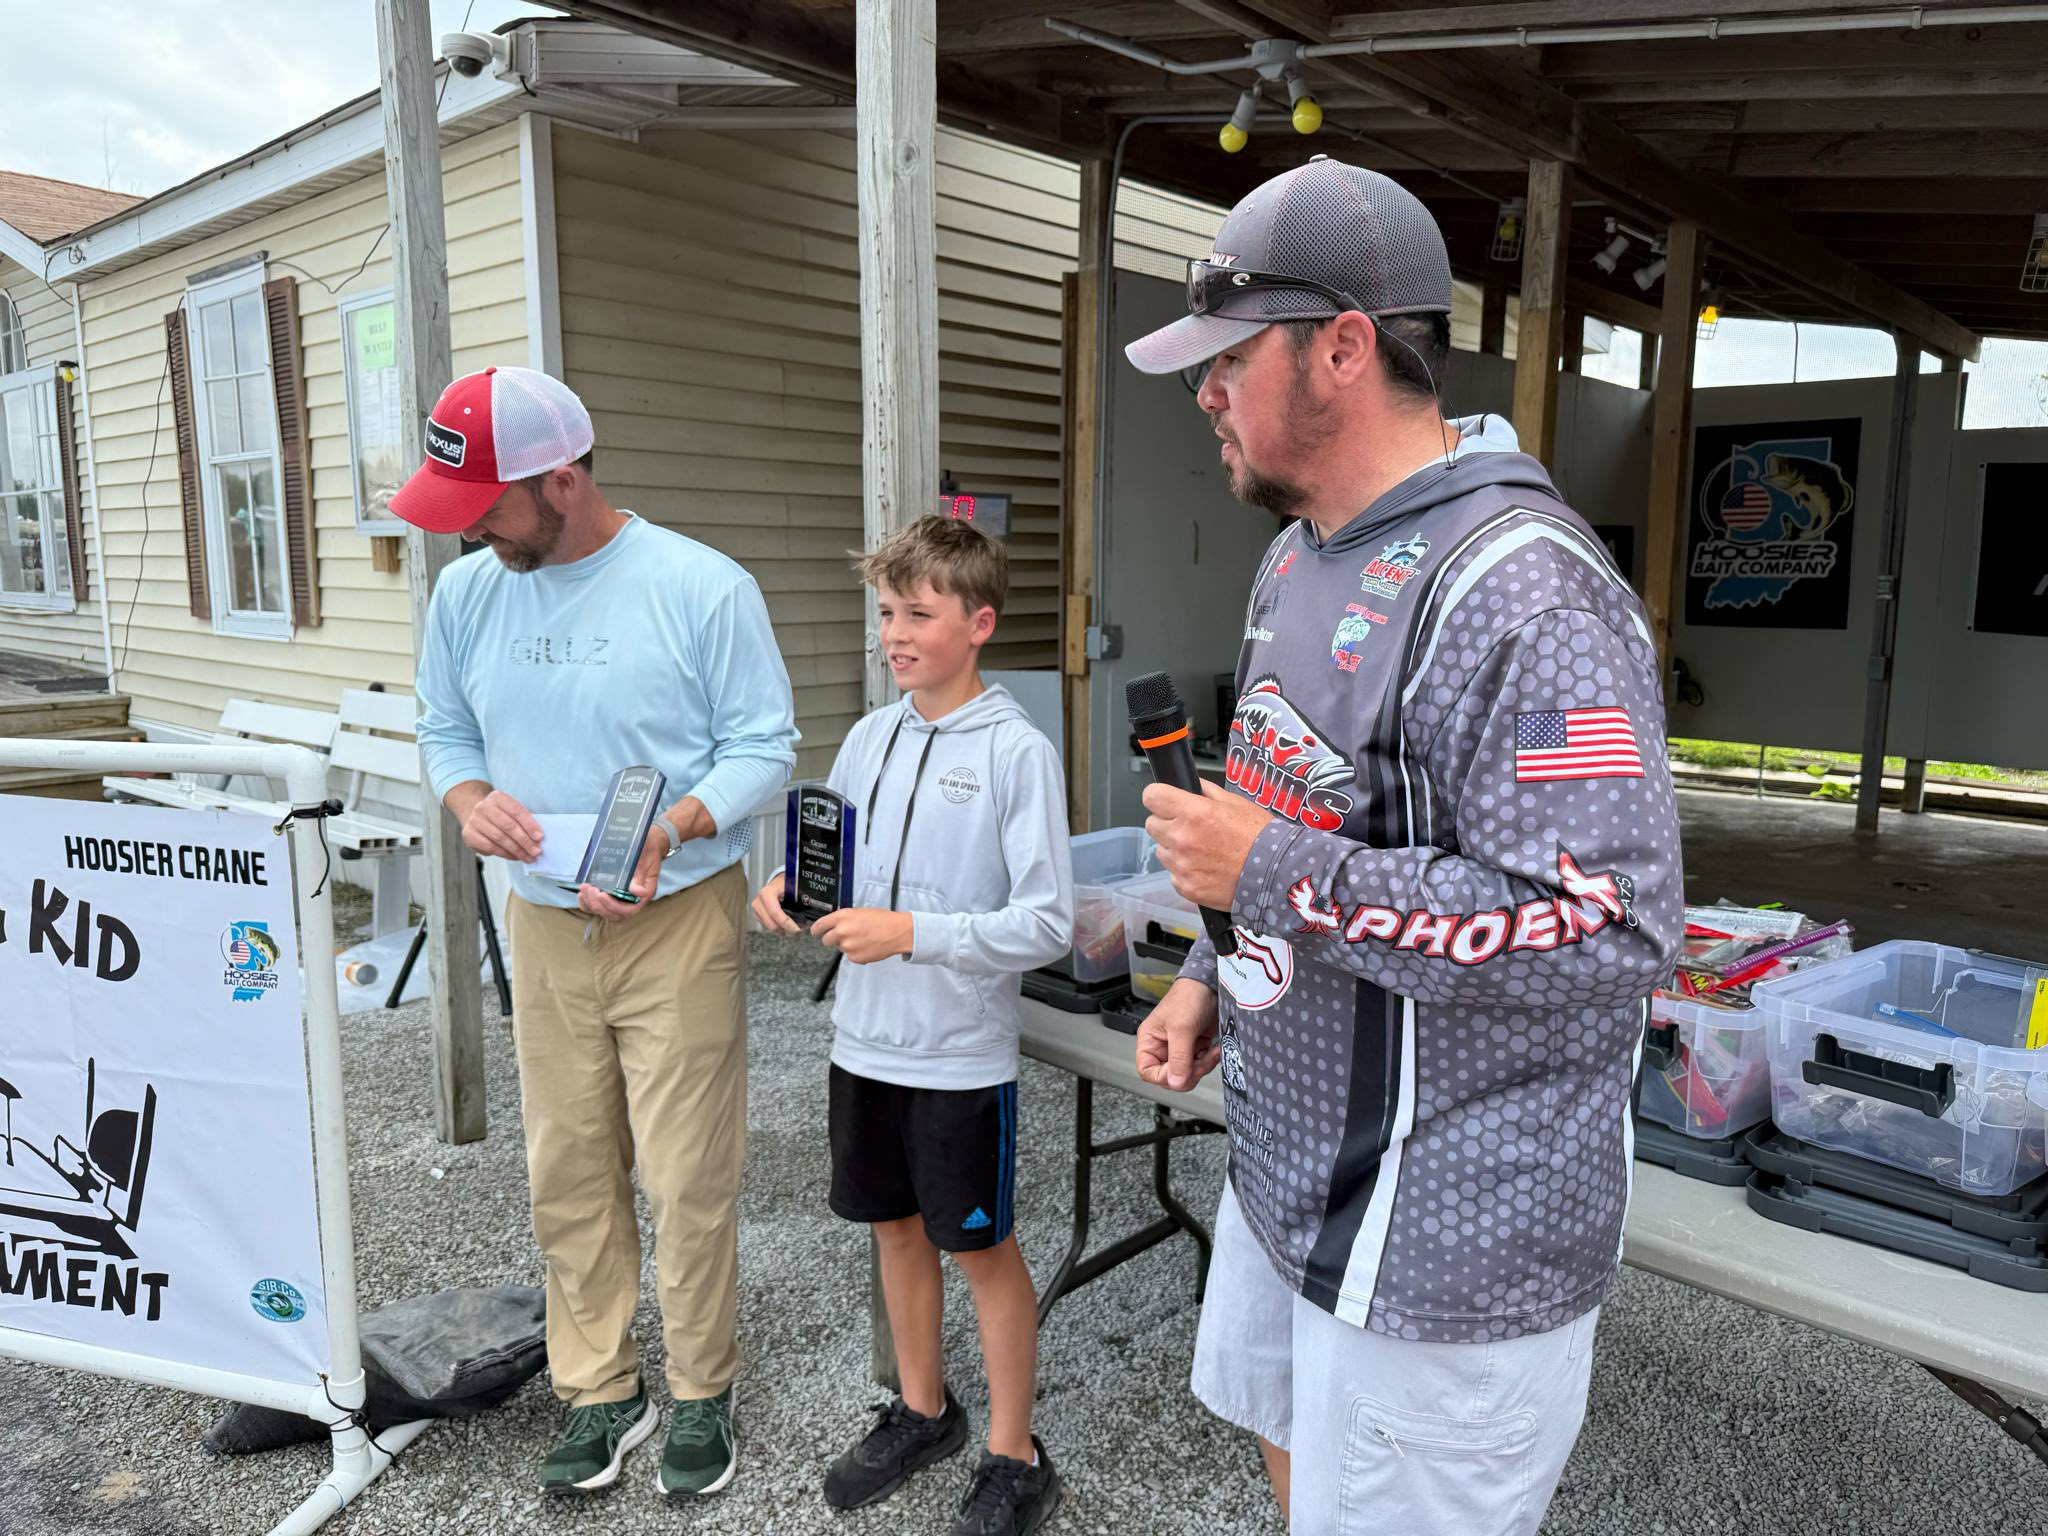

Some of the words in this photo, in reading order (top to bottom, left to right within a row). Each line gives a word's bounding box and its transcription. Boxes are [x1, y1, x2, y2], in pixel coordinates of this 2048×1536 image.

[1697, 543, 1833, 561] HOOSIER
[1363, 559, 1416, 586] ACCENT
[1693, 561, 1734, 575] BAIT
[1737, 561, 1833, 575] COMPANY
[64, 835, 174, 877] HOOSIER
[179, 845, 269, 886] CRANE
[29, 878, 141, 982] KID
[224, 970, 279, 982] HOOSIER
[241, 980, 279, 990] COMPANY
